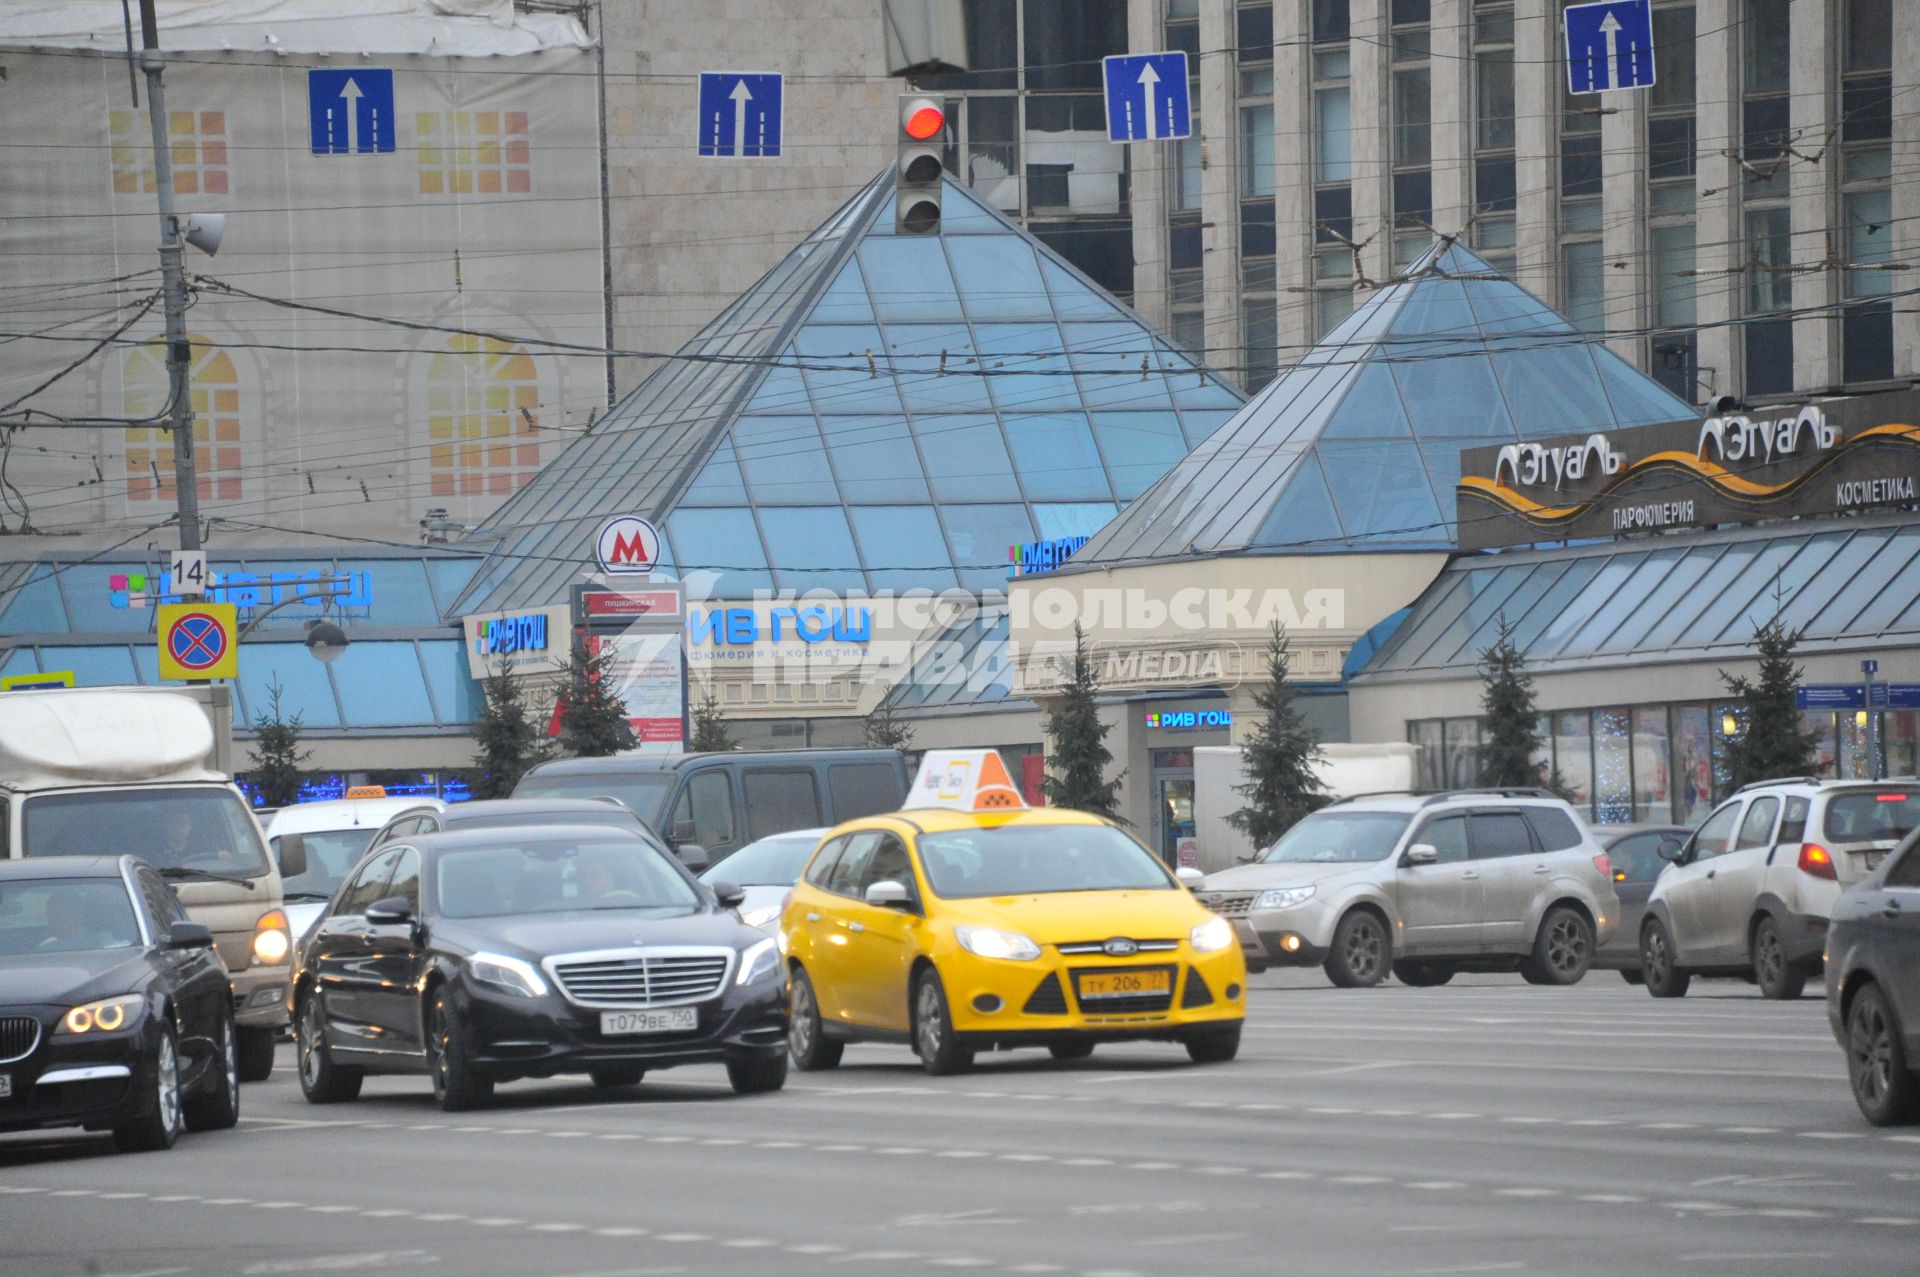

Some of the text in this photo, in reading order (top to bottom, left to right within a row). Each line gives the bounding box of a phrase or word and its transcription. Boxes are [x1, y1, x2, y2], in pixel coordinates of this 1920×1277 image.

[1836, 477, 1914, 506] КОСМЕТИКА
[1613, 500, 1694, 529] ПАРФЮМЕРИЯ
[1023, 541, 1053, 573] РИВ
[173, 559, 204, 585] 14
[517, 613, 548, 651] ГОШ
[685, 606, 872, 646] ИВ ГОШ
[786, 647, 870, 659] косметика
[1160, 711, 1232, 728] РИВ ГОШ
